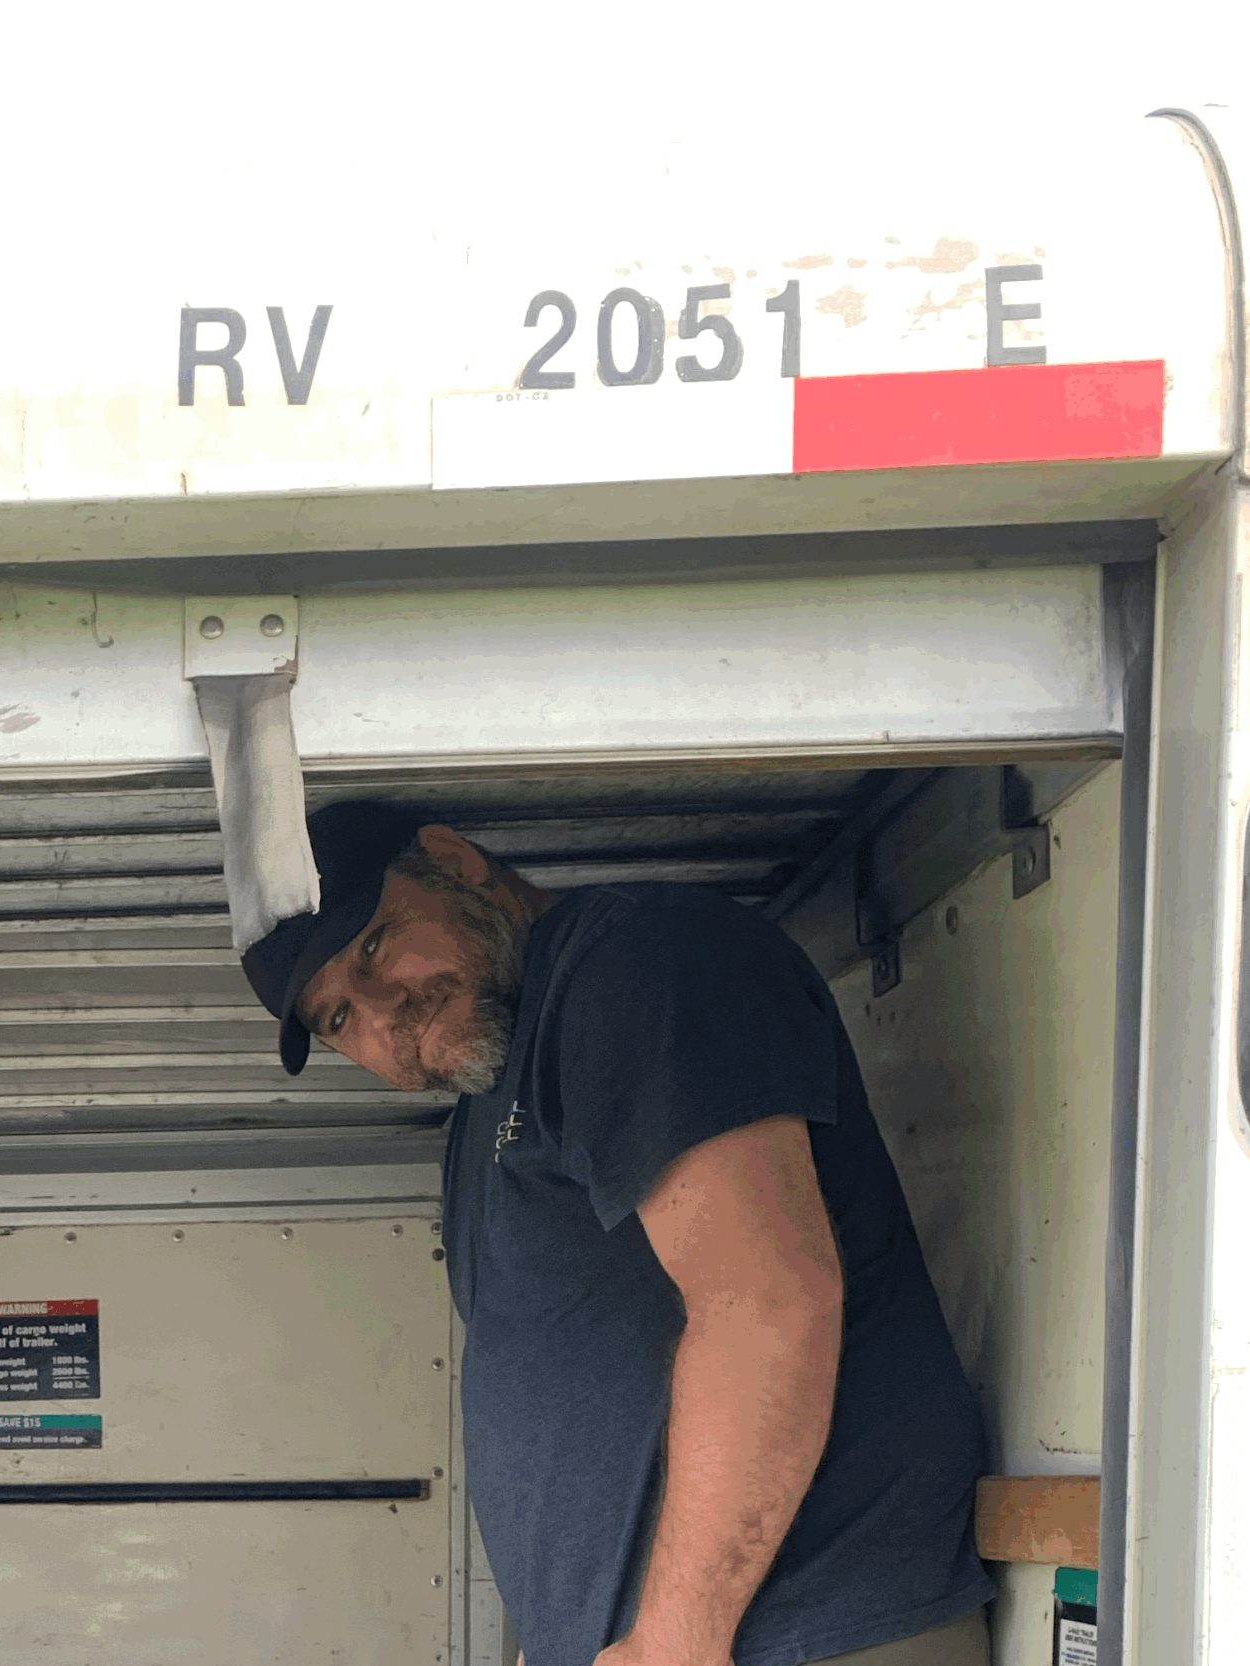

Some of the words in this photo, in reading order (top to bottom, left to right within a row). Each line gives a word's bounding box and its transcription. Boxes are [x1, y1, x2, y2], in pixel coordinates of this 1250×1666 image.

[177, 304, 333, 407] RV
[519, 278, 802, 391] 2051
[985, 264, 1048, 366] E
[2, 1325, 13, 1336] of
[15, 1326, 47, 1338] cargo
[49, 1323, 86, 1336] weight
[8, 1338, 20, 1348] of
[22, 1336, 58, 1348] trailer.
